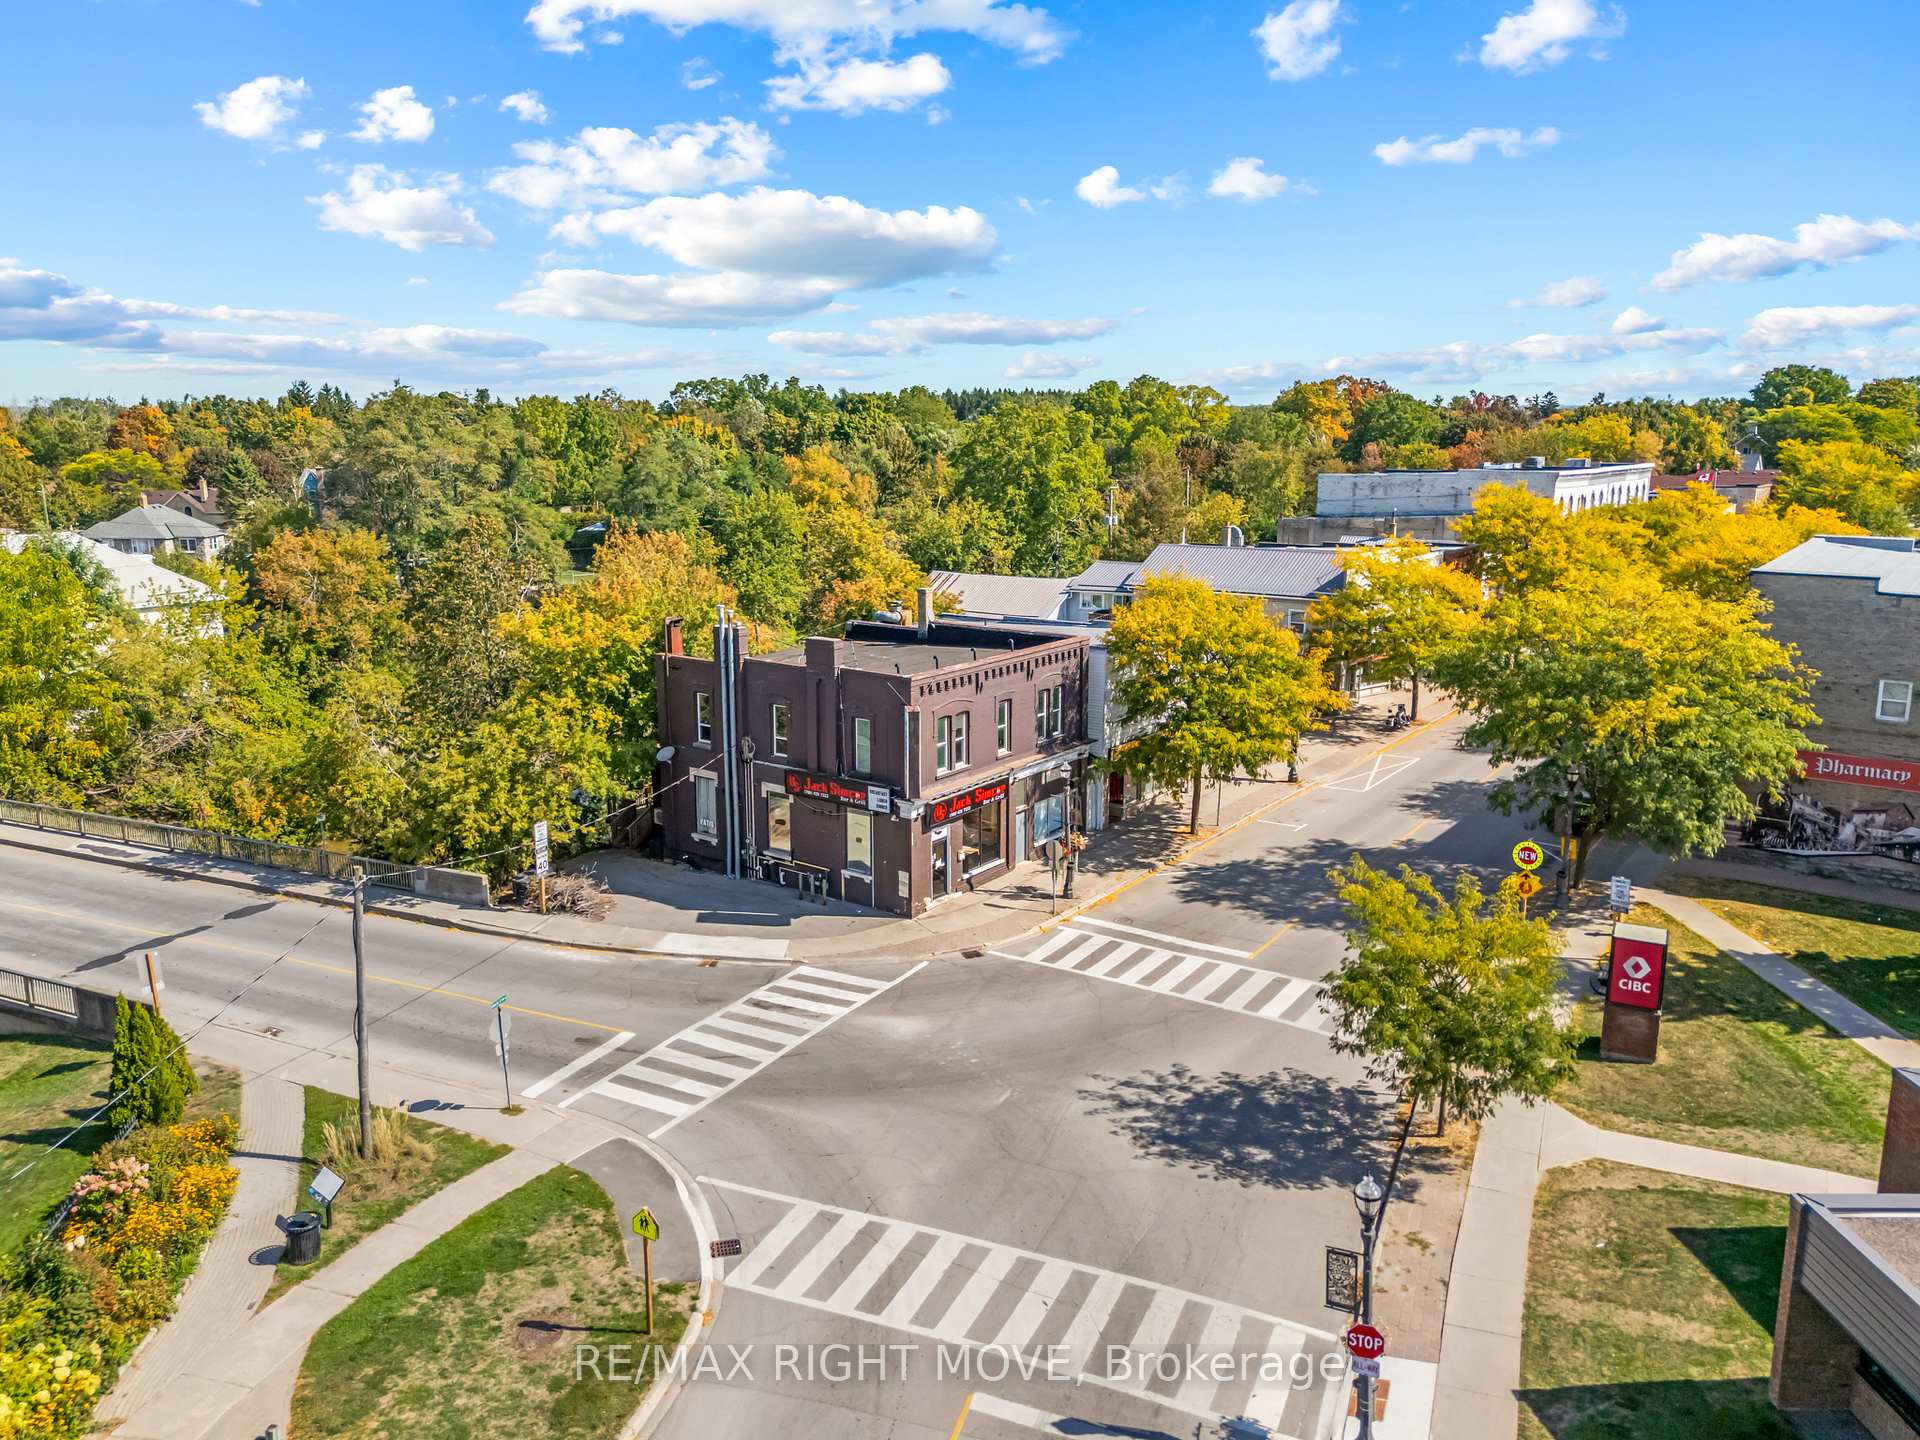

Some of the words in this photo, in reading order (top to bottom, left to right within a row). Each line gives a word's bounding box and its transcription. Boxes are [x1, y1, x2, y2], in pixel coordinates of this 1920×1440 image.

[1815, 757, 1911, 784] Pharmacy
[803, 776, 827, 794] Jack
[949, 795, 972, 813] Jack
[538, 860, 547, 869] 40
[1518, 850, 1537, 861] NEW
[1618, 978, 1651, 994] CIBC
[1348, 1332, 1382, 1350] STOP
